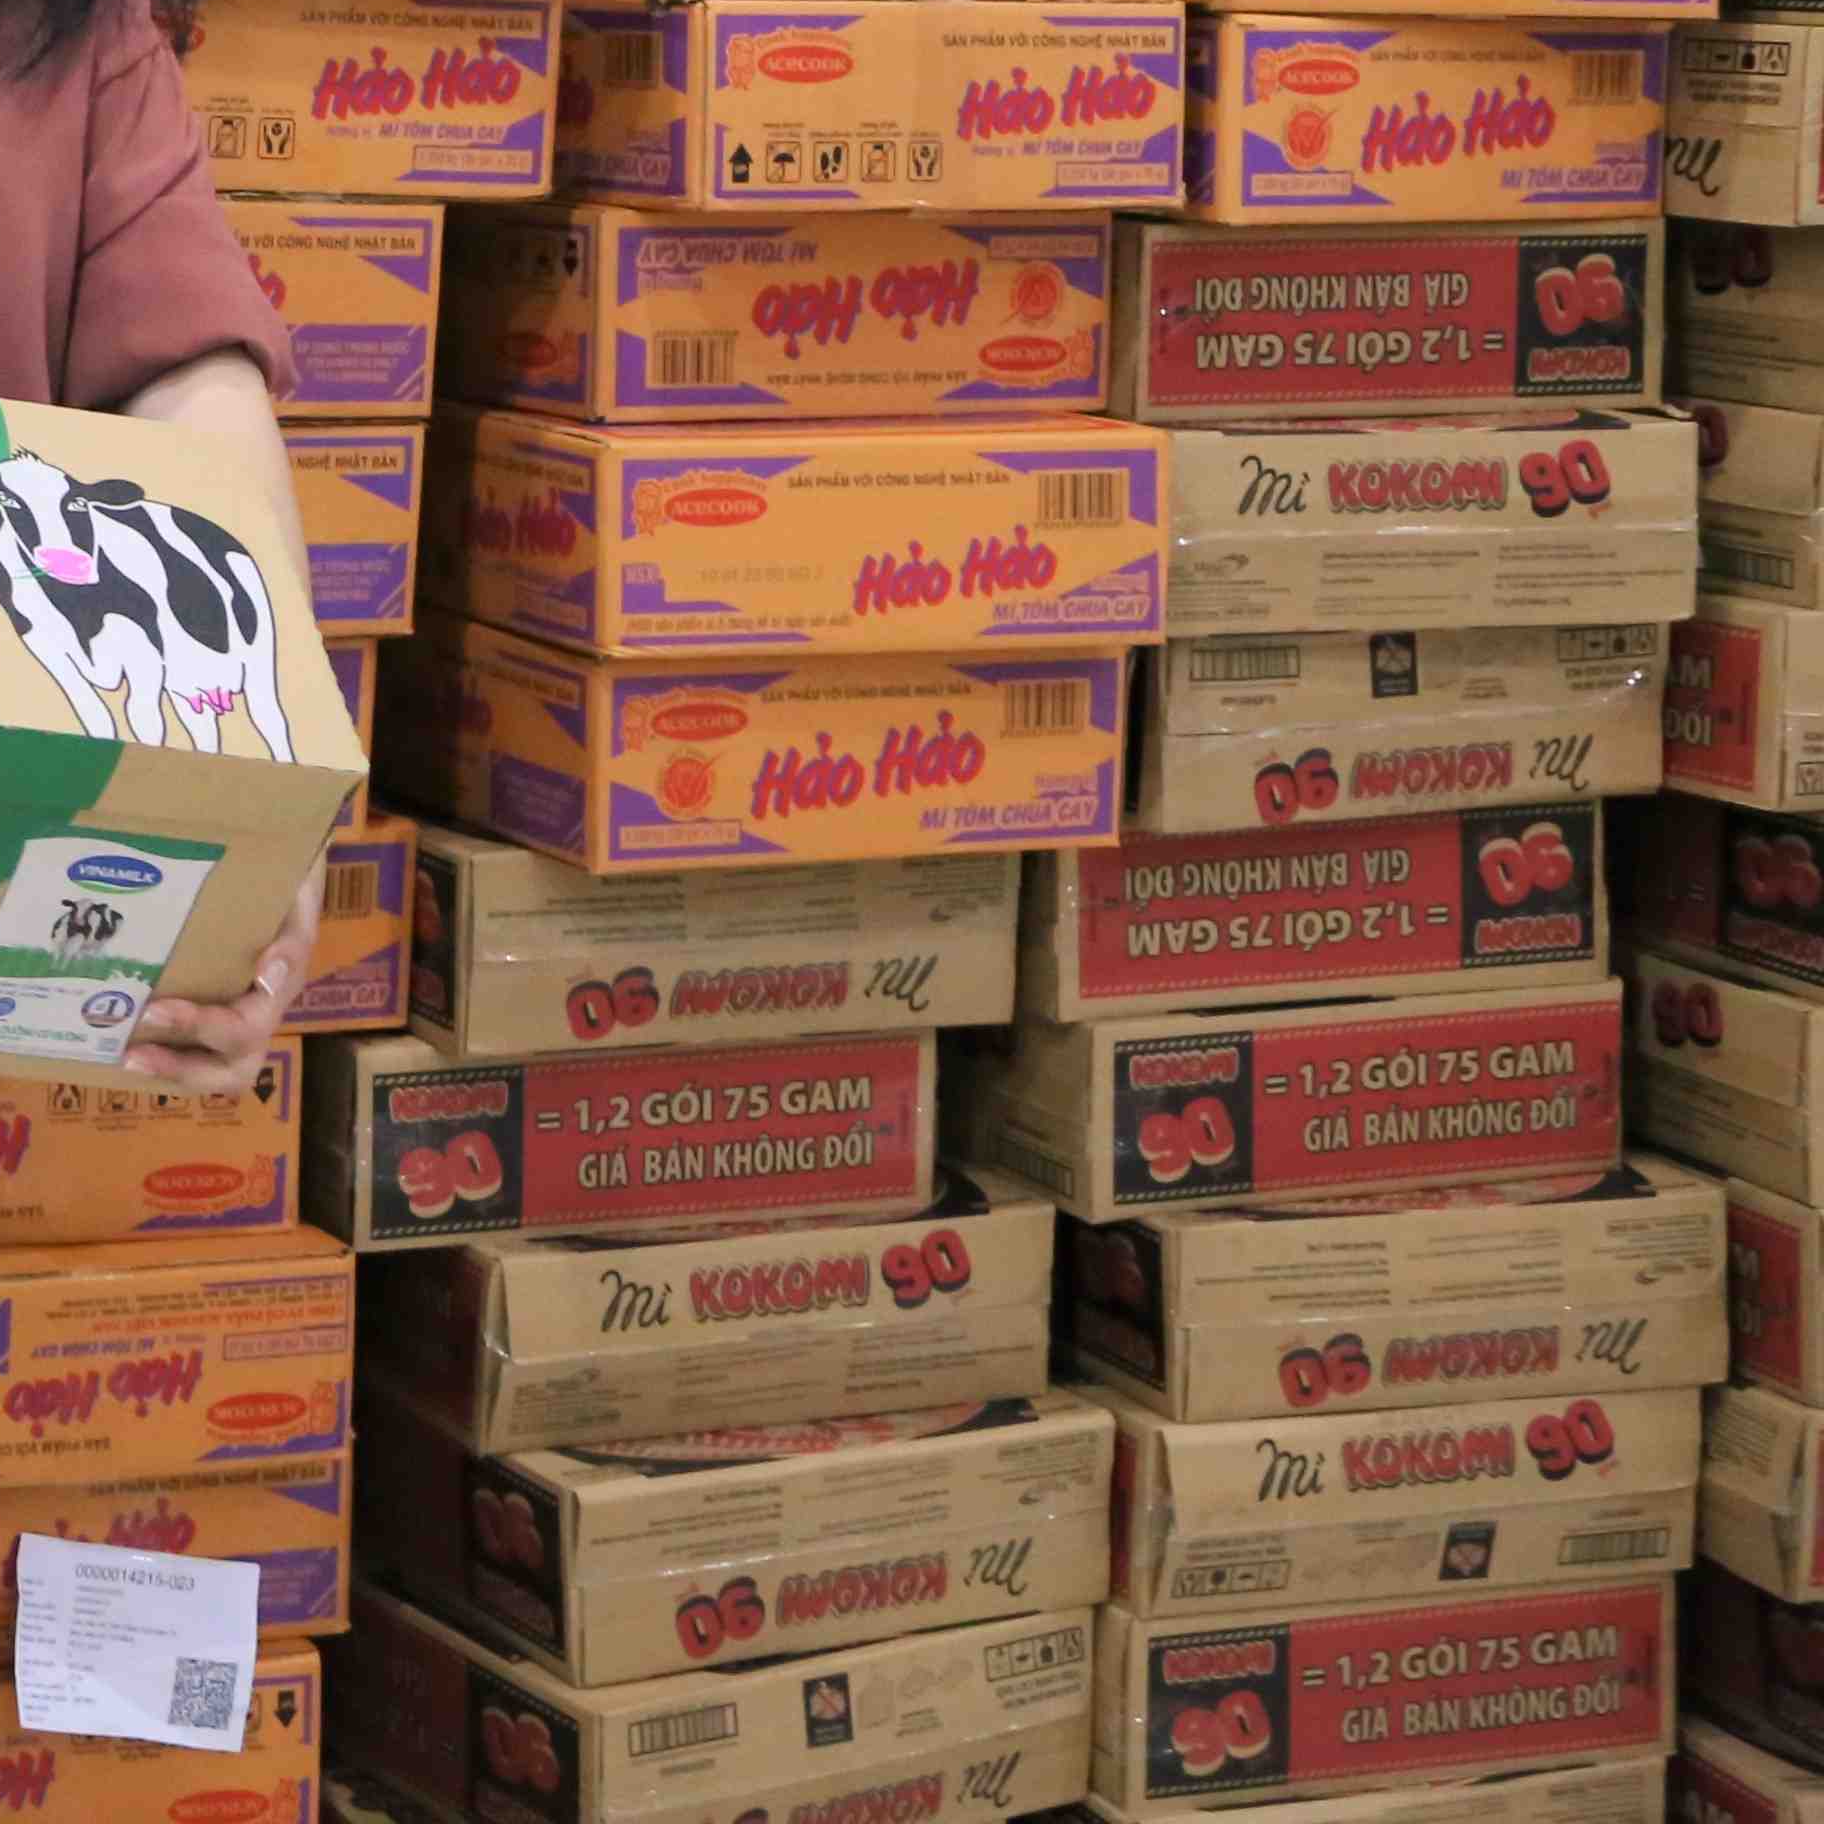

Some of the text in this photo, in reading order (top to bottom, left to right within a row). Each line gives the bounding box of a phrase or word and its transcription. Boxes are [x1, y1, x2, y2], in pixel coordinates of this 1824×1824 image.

[1238, 440, 1611, 518] Mì KOKOMI 90
[853, 526, 1057, 617] Hảo Hảo
[751, 710, 986, 820] Hảo Hảo
[574, 1077, 872, 1135] 1,2 GÓI 75 GAM
[578, 1122, 872, 1188] GIÁ BÁN KHÔNG ĐỔI
[600, 1229, 972, 1332] Mì KOKOMI 90
[1342, 1399, 1614, 1490] KOKOMI 90
